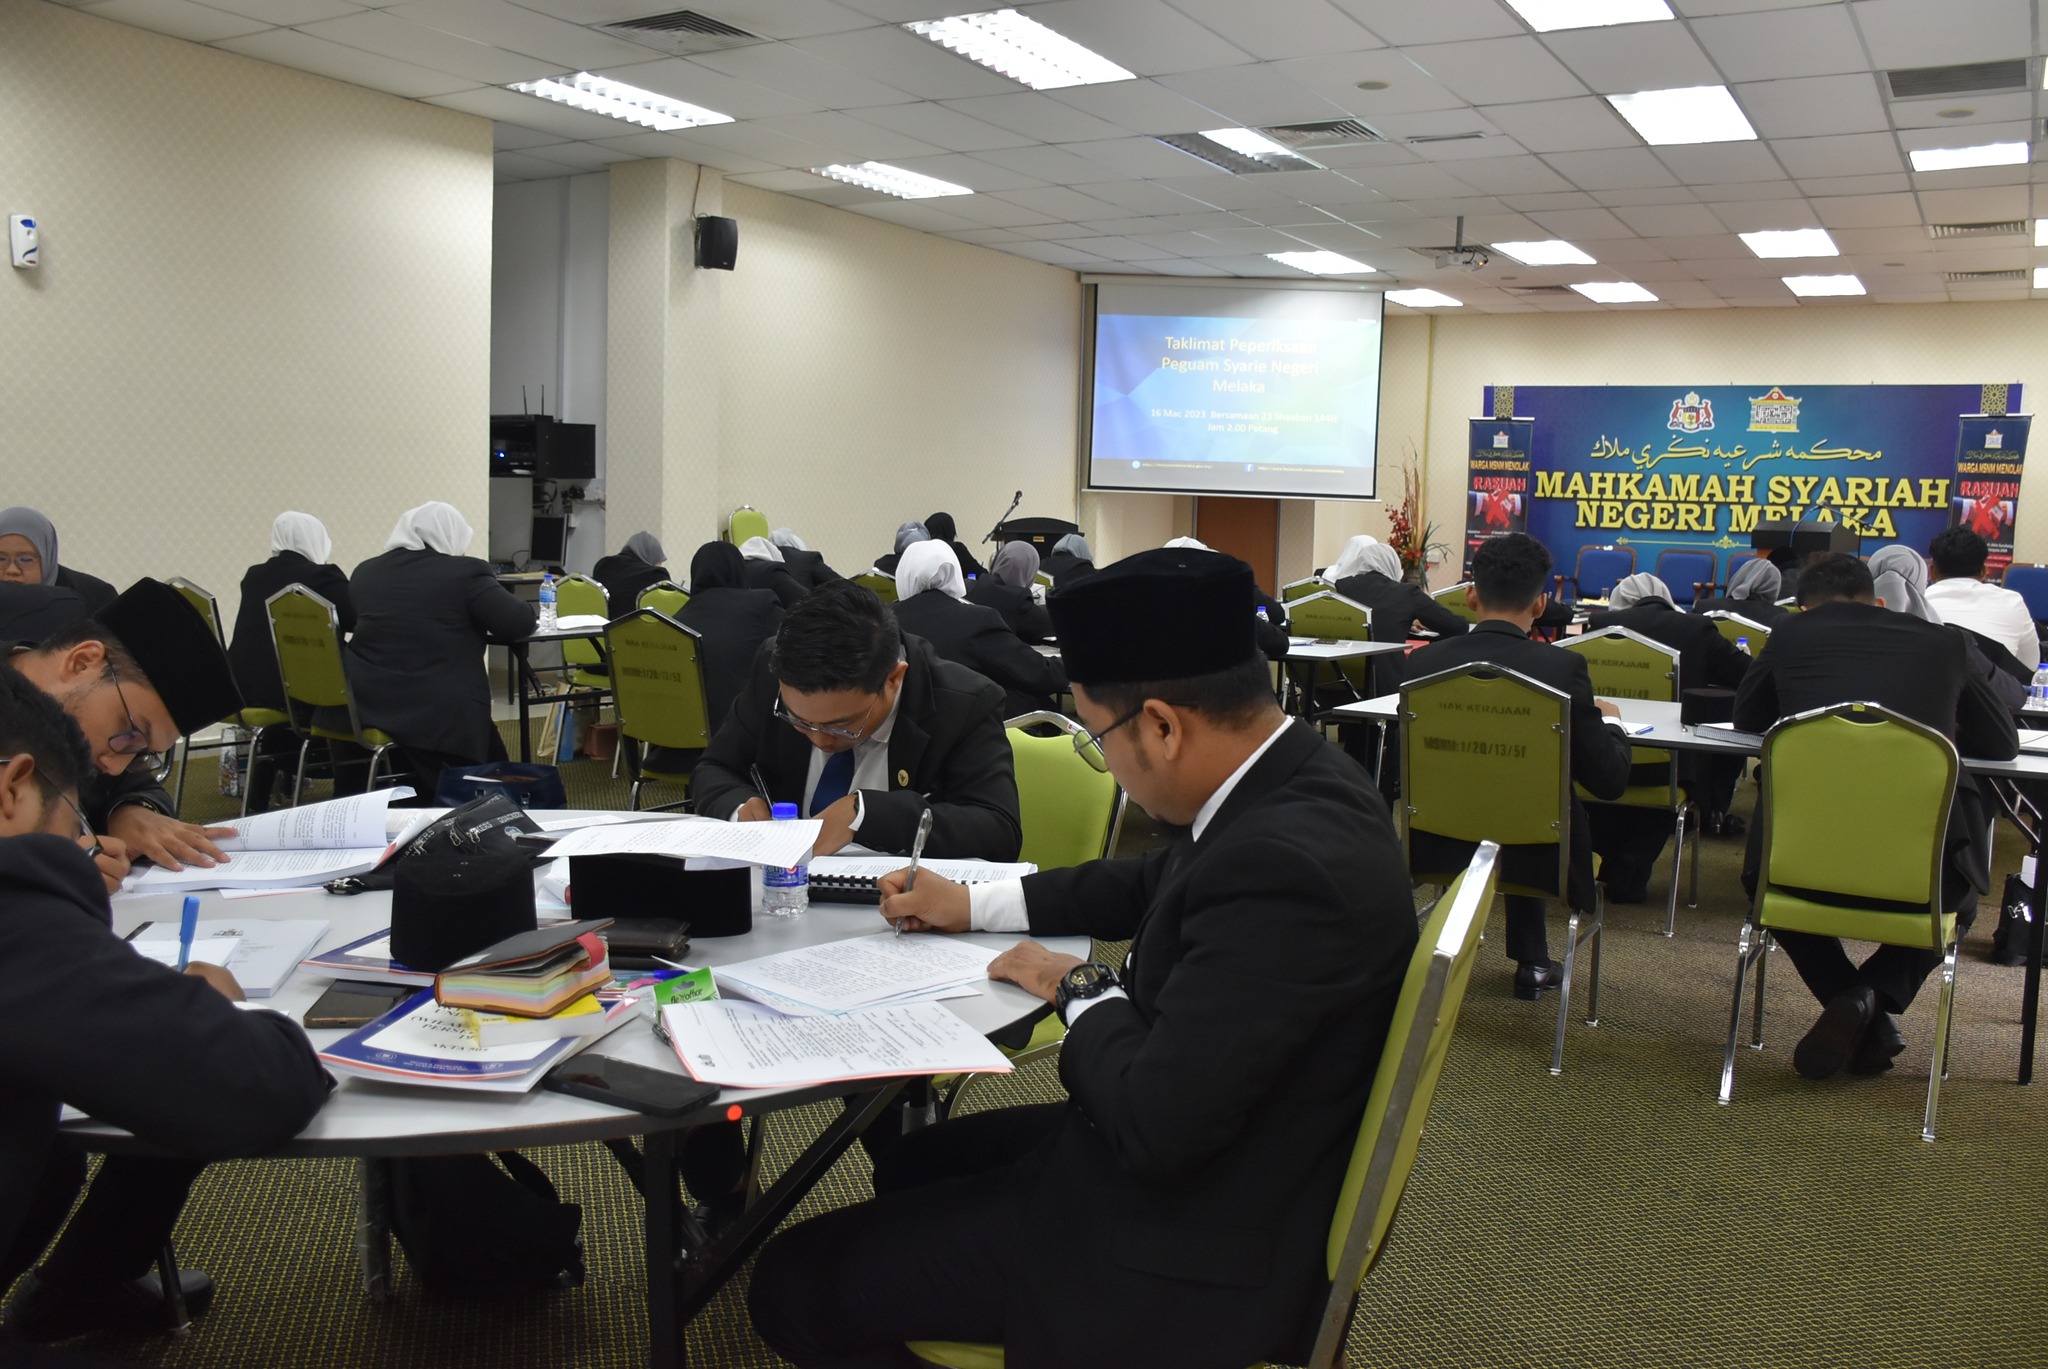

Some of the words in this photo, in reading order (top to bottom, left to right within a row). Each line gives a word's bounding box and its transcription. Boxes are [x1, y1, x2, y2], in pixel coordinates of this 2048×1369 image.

[1164, 335, 1226, 351] Taklimat
[1229, 338, 1318, 354] Peperiksaan
[1161, 357, 1219, 373] Peguam
[1223, 359, 1267, 375] Syarie
[1271, 360, 1319, 376] Negeri
[1212, 379, 1265, 394] Melaka
[1151, 408, 1162, 418] 16
[1163, 409, 1182, 418] Mac
[1184, 409, 1206, 419] 2023
[1210, 410, 1259, 421] Bersamaan
[1207, 423, 1224, 432] Jam
[1226, 423, 1246, 432] 2.00
[1248, 424, 1279, 435] Petang
[1957, 462, 1979, 474] WARGA
[1473, 475, 1527, 492] RASUAH
[1534, 471, 1756, 503] MAHKAMAH
[1767, 475, 1951, 508] SYARIAH
[1960, 480, 2020, 498] RASUAH
[1574, 500, 1716, 531] NEGERI
[1466, 704, 1531, 716] KERAJAAN
